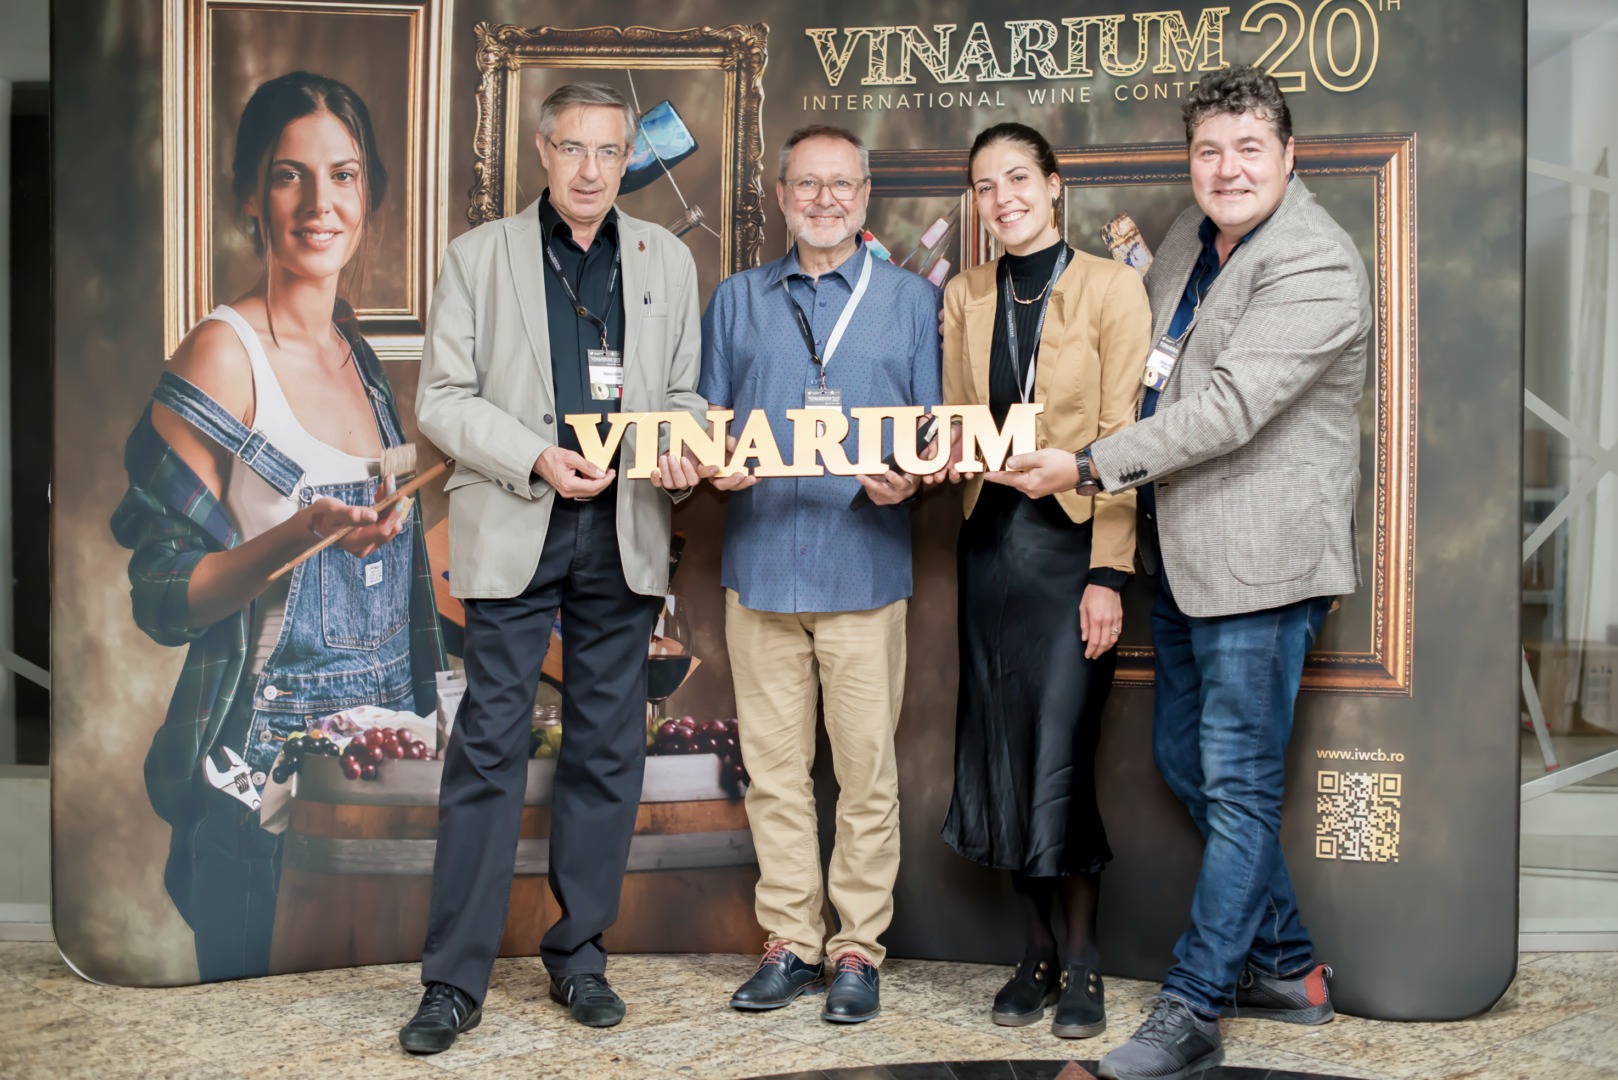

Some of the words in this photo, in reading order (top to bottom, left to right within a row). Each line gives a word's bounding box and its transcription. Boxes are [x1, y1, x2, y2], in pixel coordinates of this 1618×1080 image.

[804, 6, 1231, 87] VINARIUM
[803, 90, 1006, 111] INTERNATIONAL
[1028, 86, 1092, 105] WINE
[1114, 81, 1201, 102] CONT
[564, 403, 1044, 479] VINARIUM
[1316, 748, 1405, 763] www.iwcb.ro
